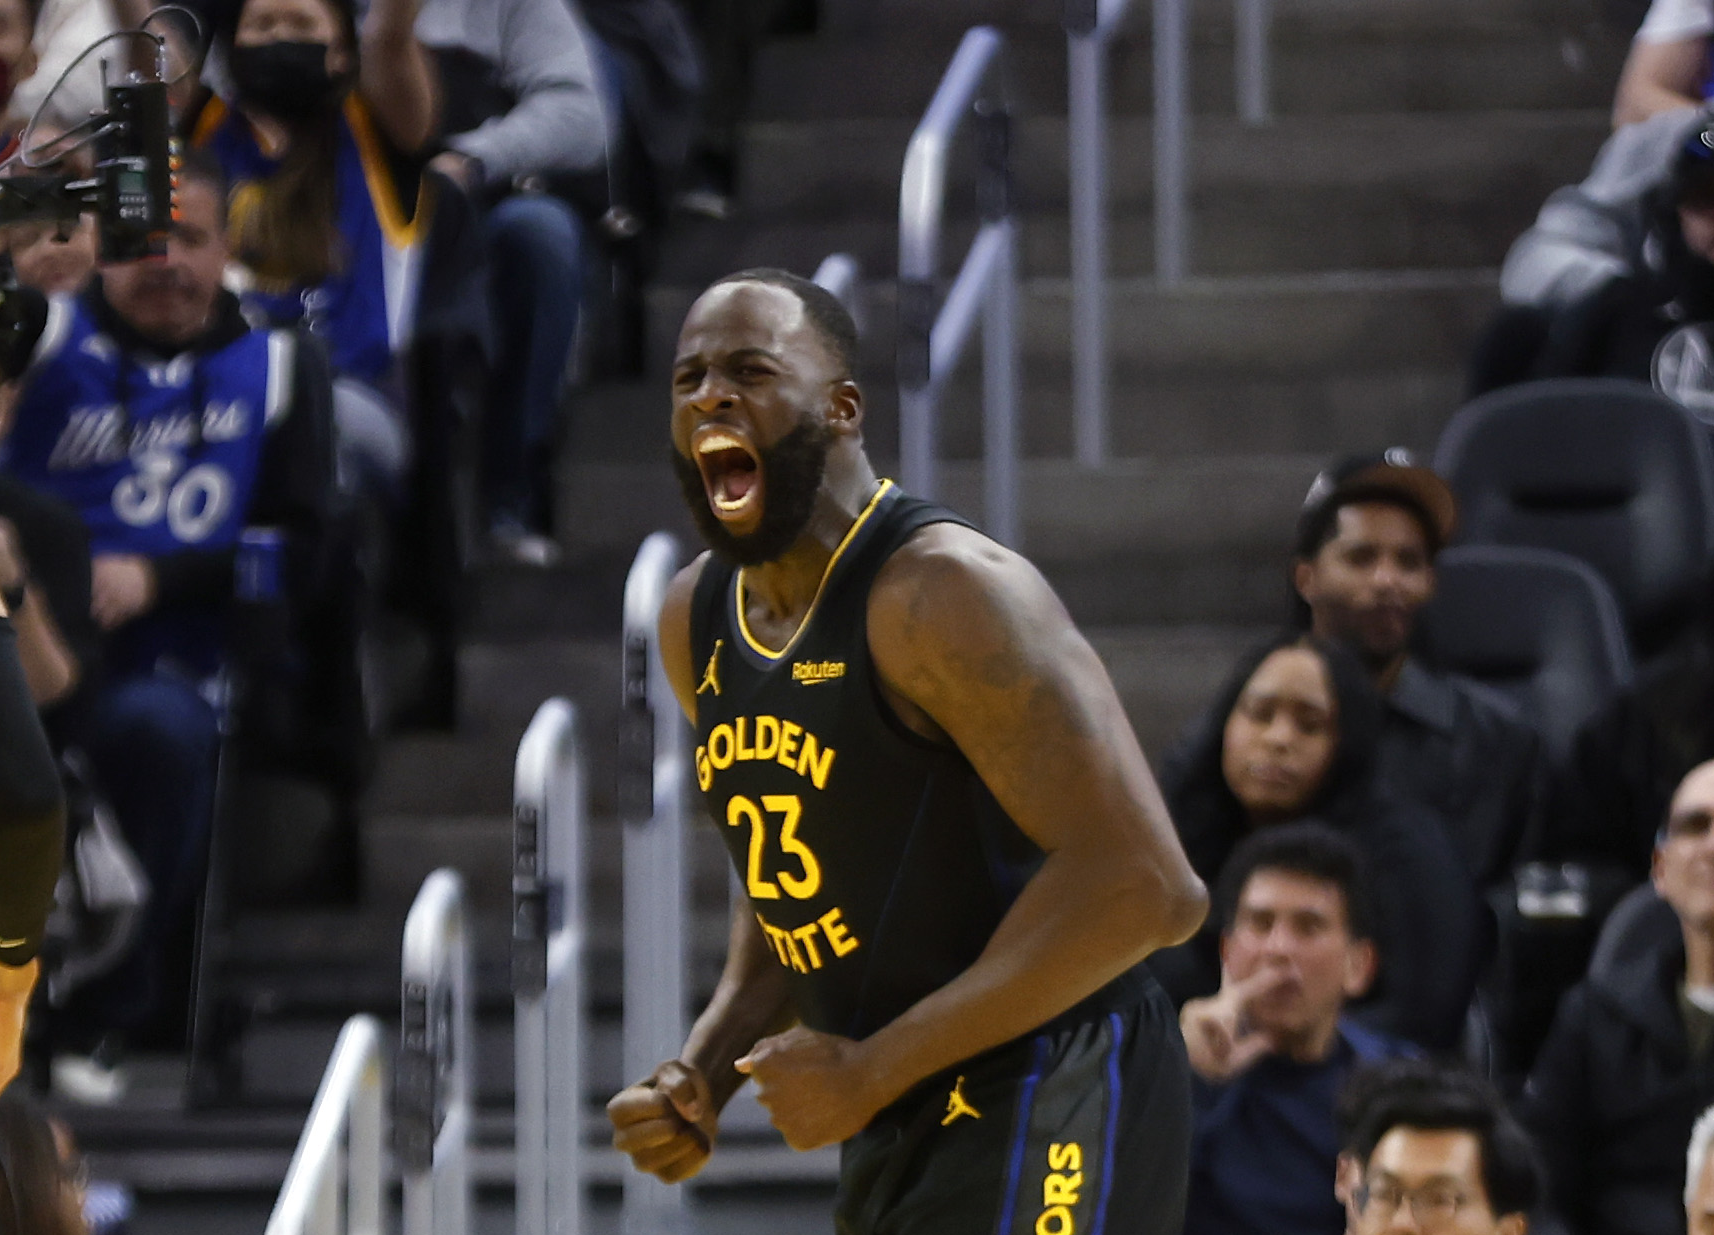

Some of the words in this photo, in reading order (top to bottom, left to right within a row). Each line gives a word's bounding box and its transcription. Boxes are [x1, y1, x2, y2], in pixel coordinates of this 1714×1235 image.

[792, 660, 846, 686] Rakuten
[695, 714, 836, 792] GOLDEN
[726, 794, 822, 900] 23
